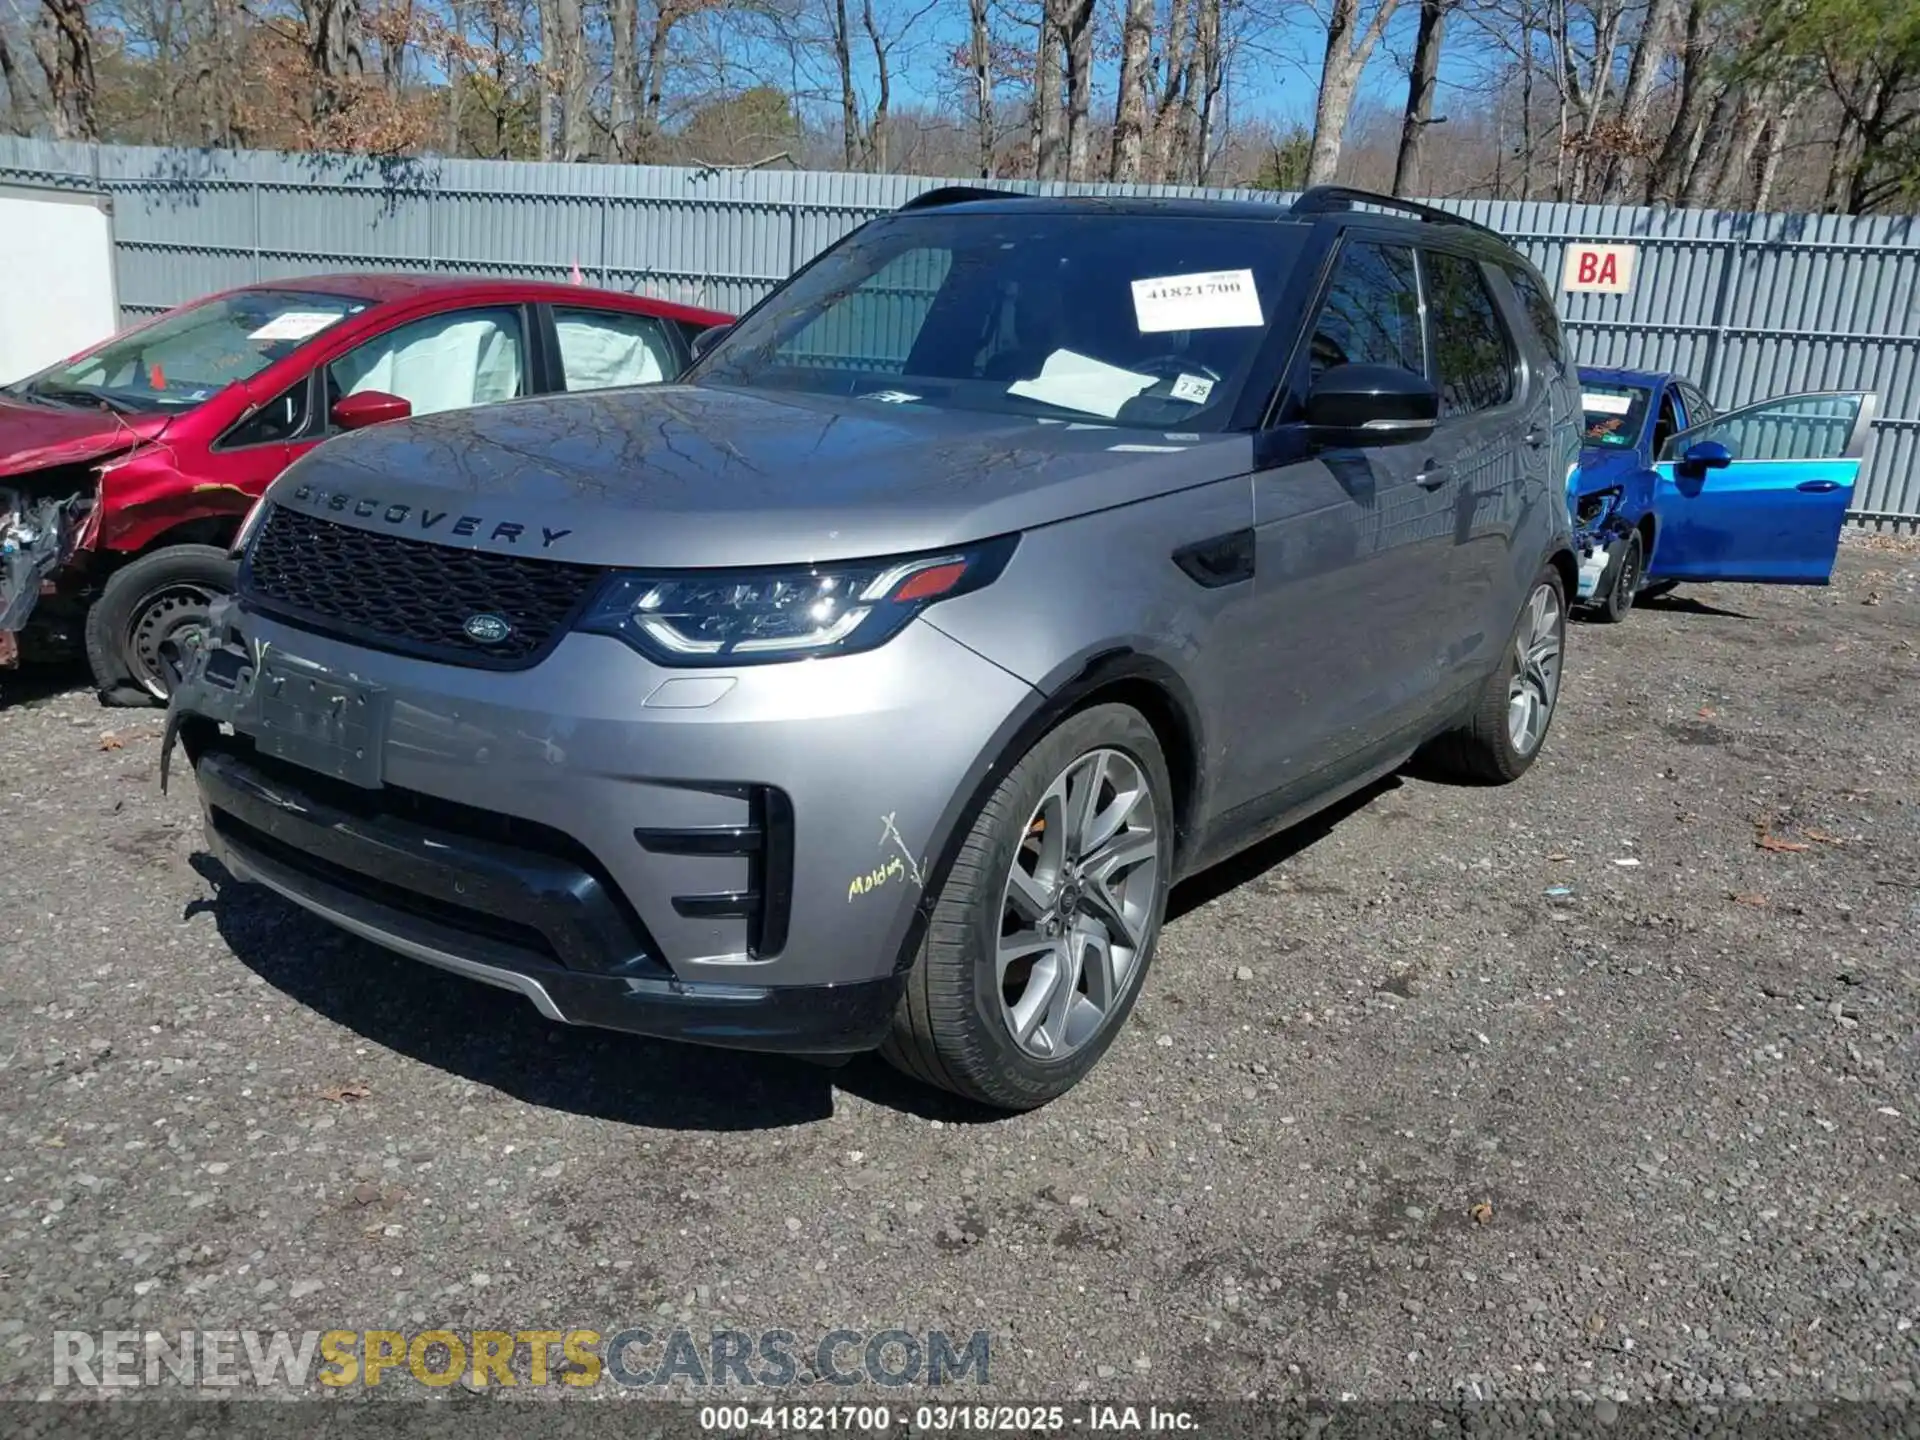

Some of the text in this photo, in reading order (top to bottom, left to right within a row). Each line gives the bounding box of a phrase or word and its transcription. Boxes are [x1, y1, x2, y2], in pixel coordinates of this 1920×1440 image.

[1578, 252, 1617, 284] BA
[1147, 282, 1241, 299] 41821700
[1193, 385, 1207, 396] 25
[294, 484, 573, 548] DISCOVERY
